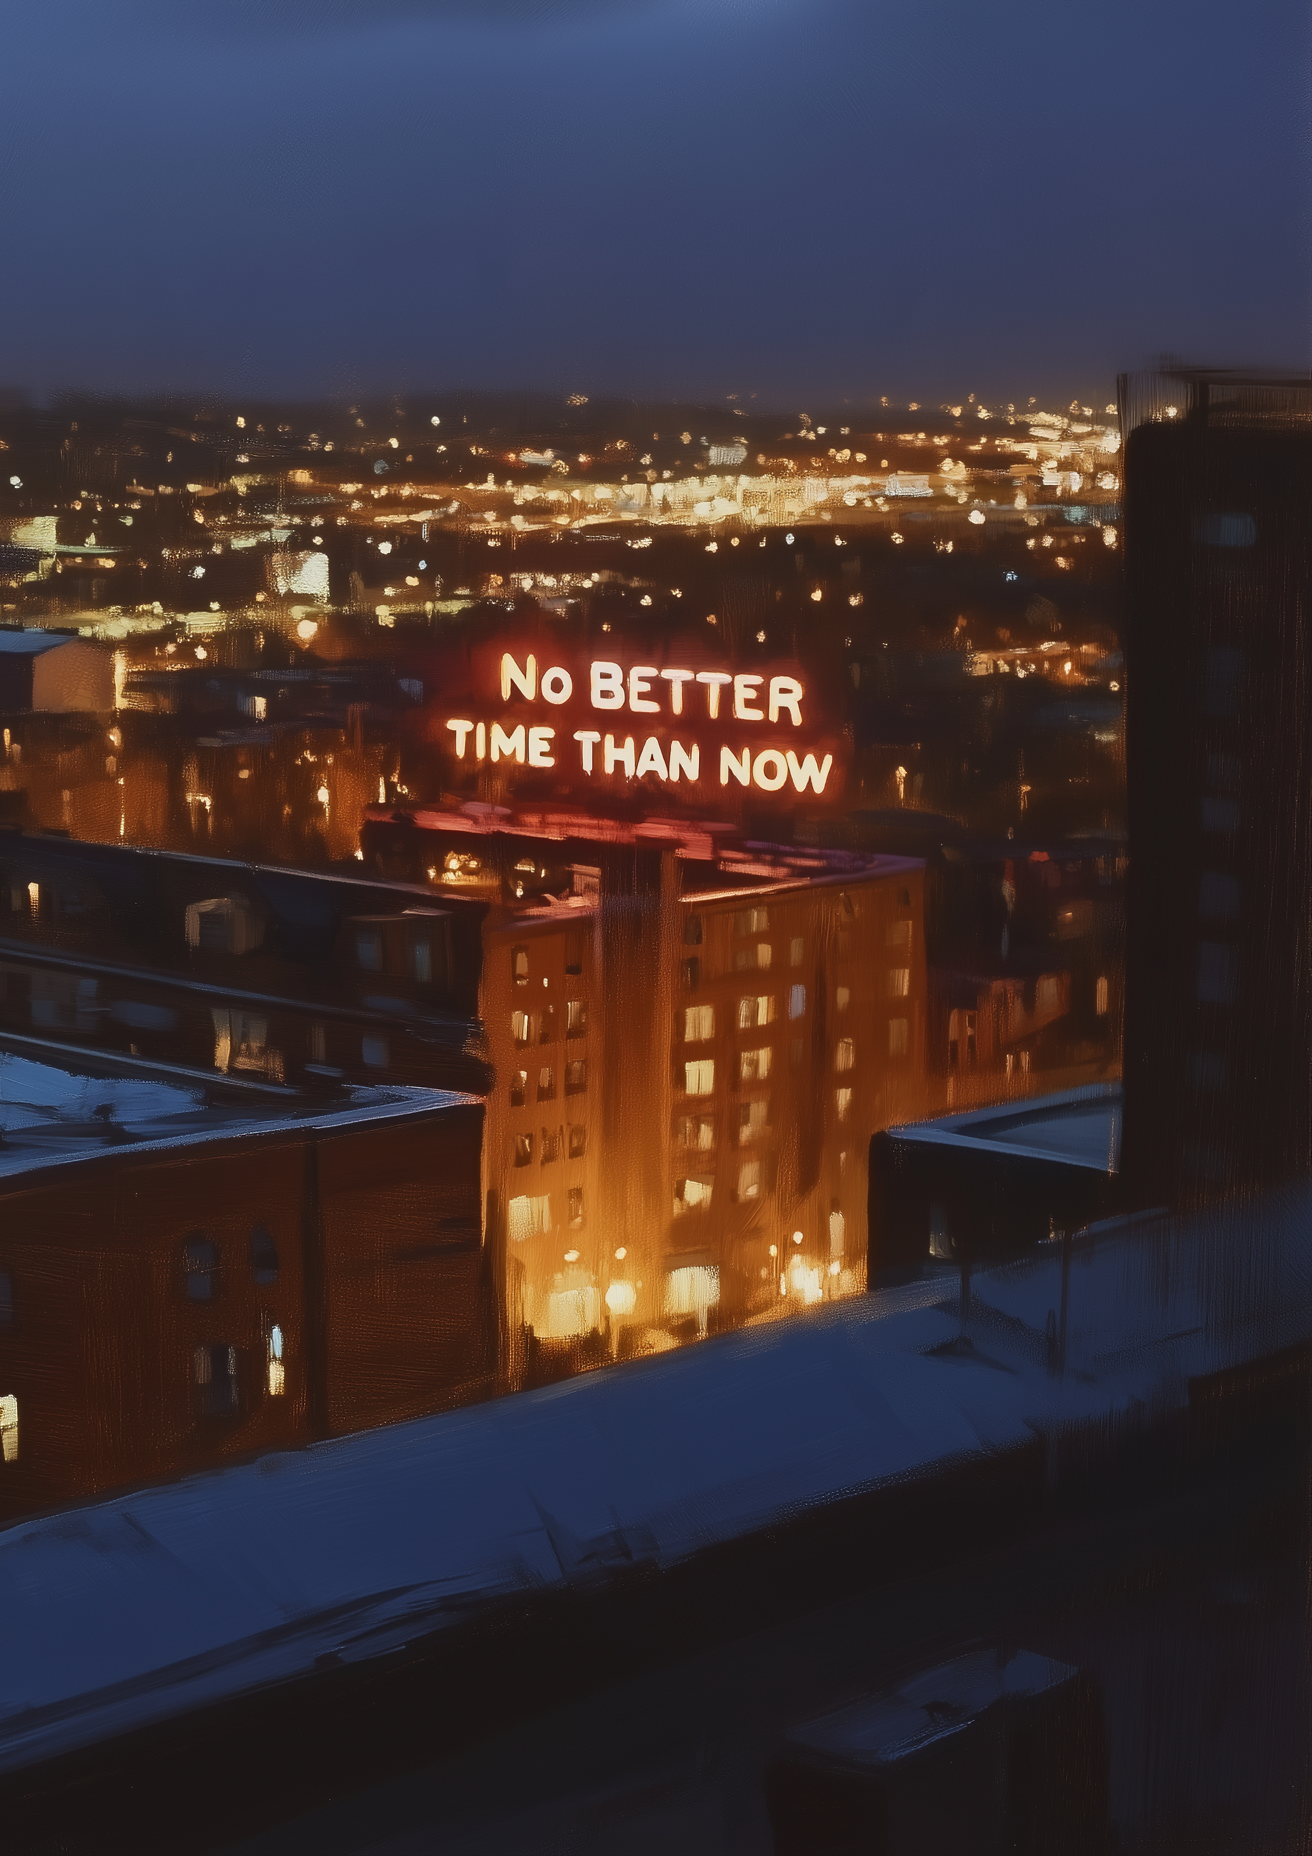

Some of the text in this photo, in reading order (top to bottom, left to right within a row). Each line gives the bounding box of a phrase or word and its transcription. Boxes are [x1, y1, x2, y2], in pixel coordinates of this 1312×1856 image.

[589, 659, 804, 728] BETTER
[445, 718, 834, 796] TIME THAN NOW
